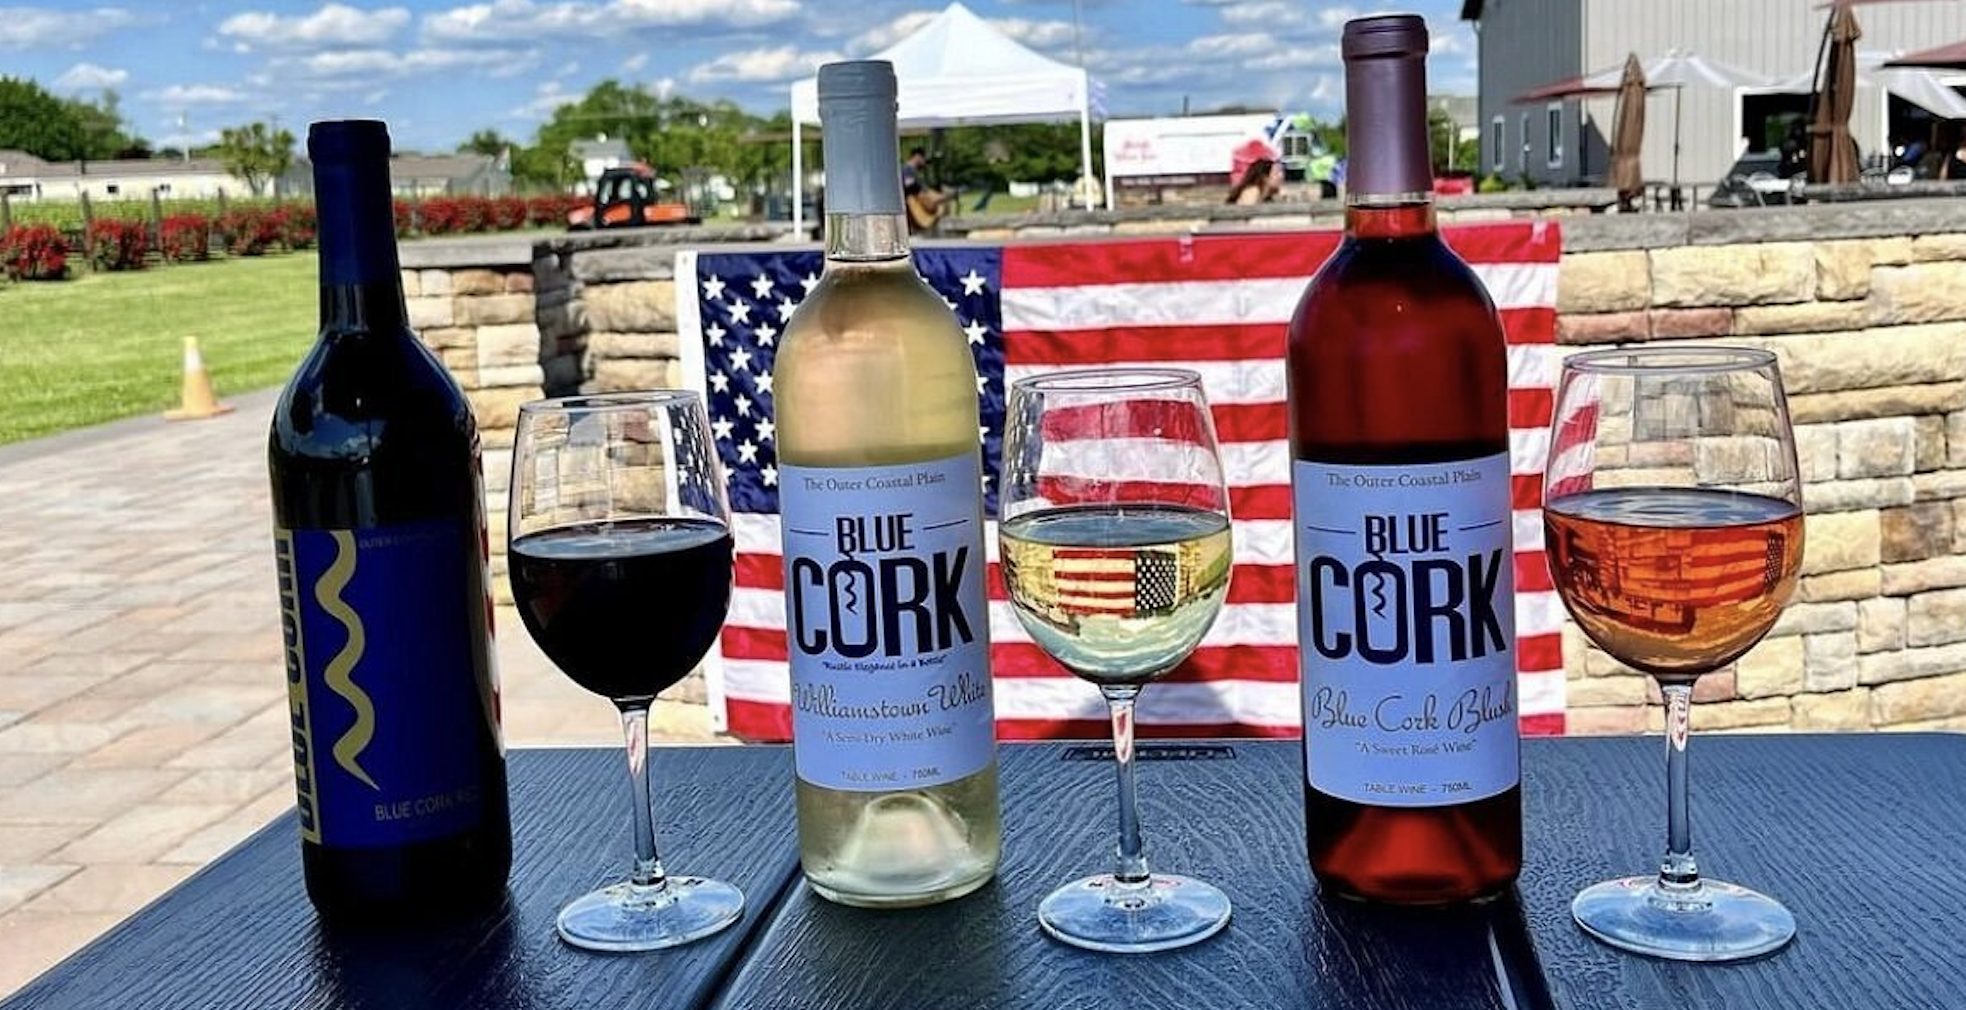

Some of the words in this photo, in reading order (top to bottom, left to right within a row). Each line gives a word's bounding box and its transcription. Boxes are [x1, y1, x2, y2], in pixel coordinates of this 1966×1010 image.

[804, 477, 823, 491] The
[826, 477, 863, 491] Outer
[866, 475, 914, 490] Coastal
[917, 472, 946, 486] Plain
[1327, 473, 1350, 487] The
[1354, 474, 1395, 488] Outer
[1398, 472, 1449, 487] Coastal
[1453, 470, 1482, 483] Plain
[836, 513, 915, 554] BLUE
[1365, 513, 1450, 554] BLUE
[792, 546, 974, 659] CORK
[1310, 547, 1506, 665] CORK
[793, 683, 931, 719] Williamstown
[1312, 686, 1368, 729] Blue
[1375, 695, 1440, 733] Cork
[1447, 679, 1513, 734] Blush
[1363, 782, 1396, 793] TABLE
[1398, 783, 1427, 794] WINE
[374, 800, 412, 821] BLUE
